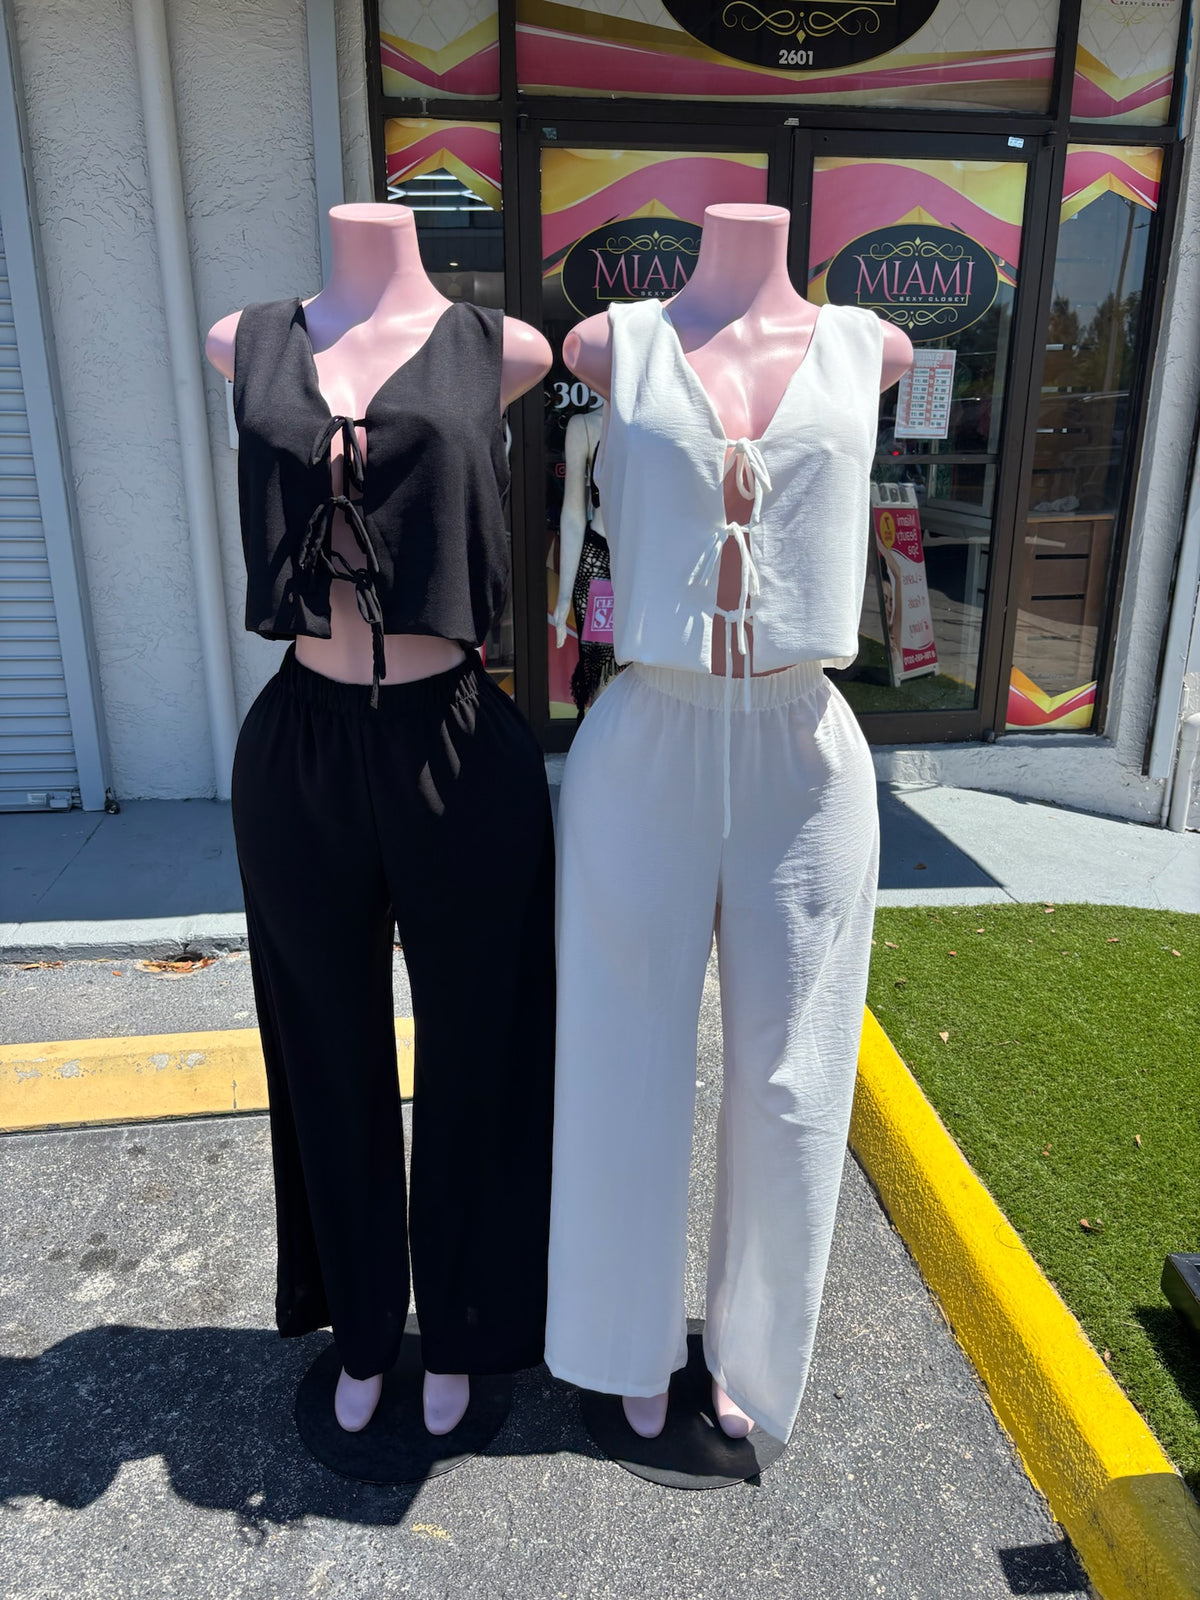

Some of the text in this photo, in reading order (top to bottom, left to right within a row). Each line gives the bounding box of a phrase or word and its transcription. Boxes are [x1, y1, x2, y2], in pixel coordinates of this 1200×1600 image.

[779, 49, 814, 65] 2601
[588, 248, 689, 297] MIA
[852, 255, 976, 303] MIAMI
[553, 382, 604, 409] 305
